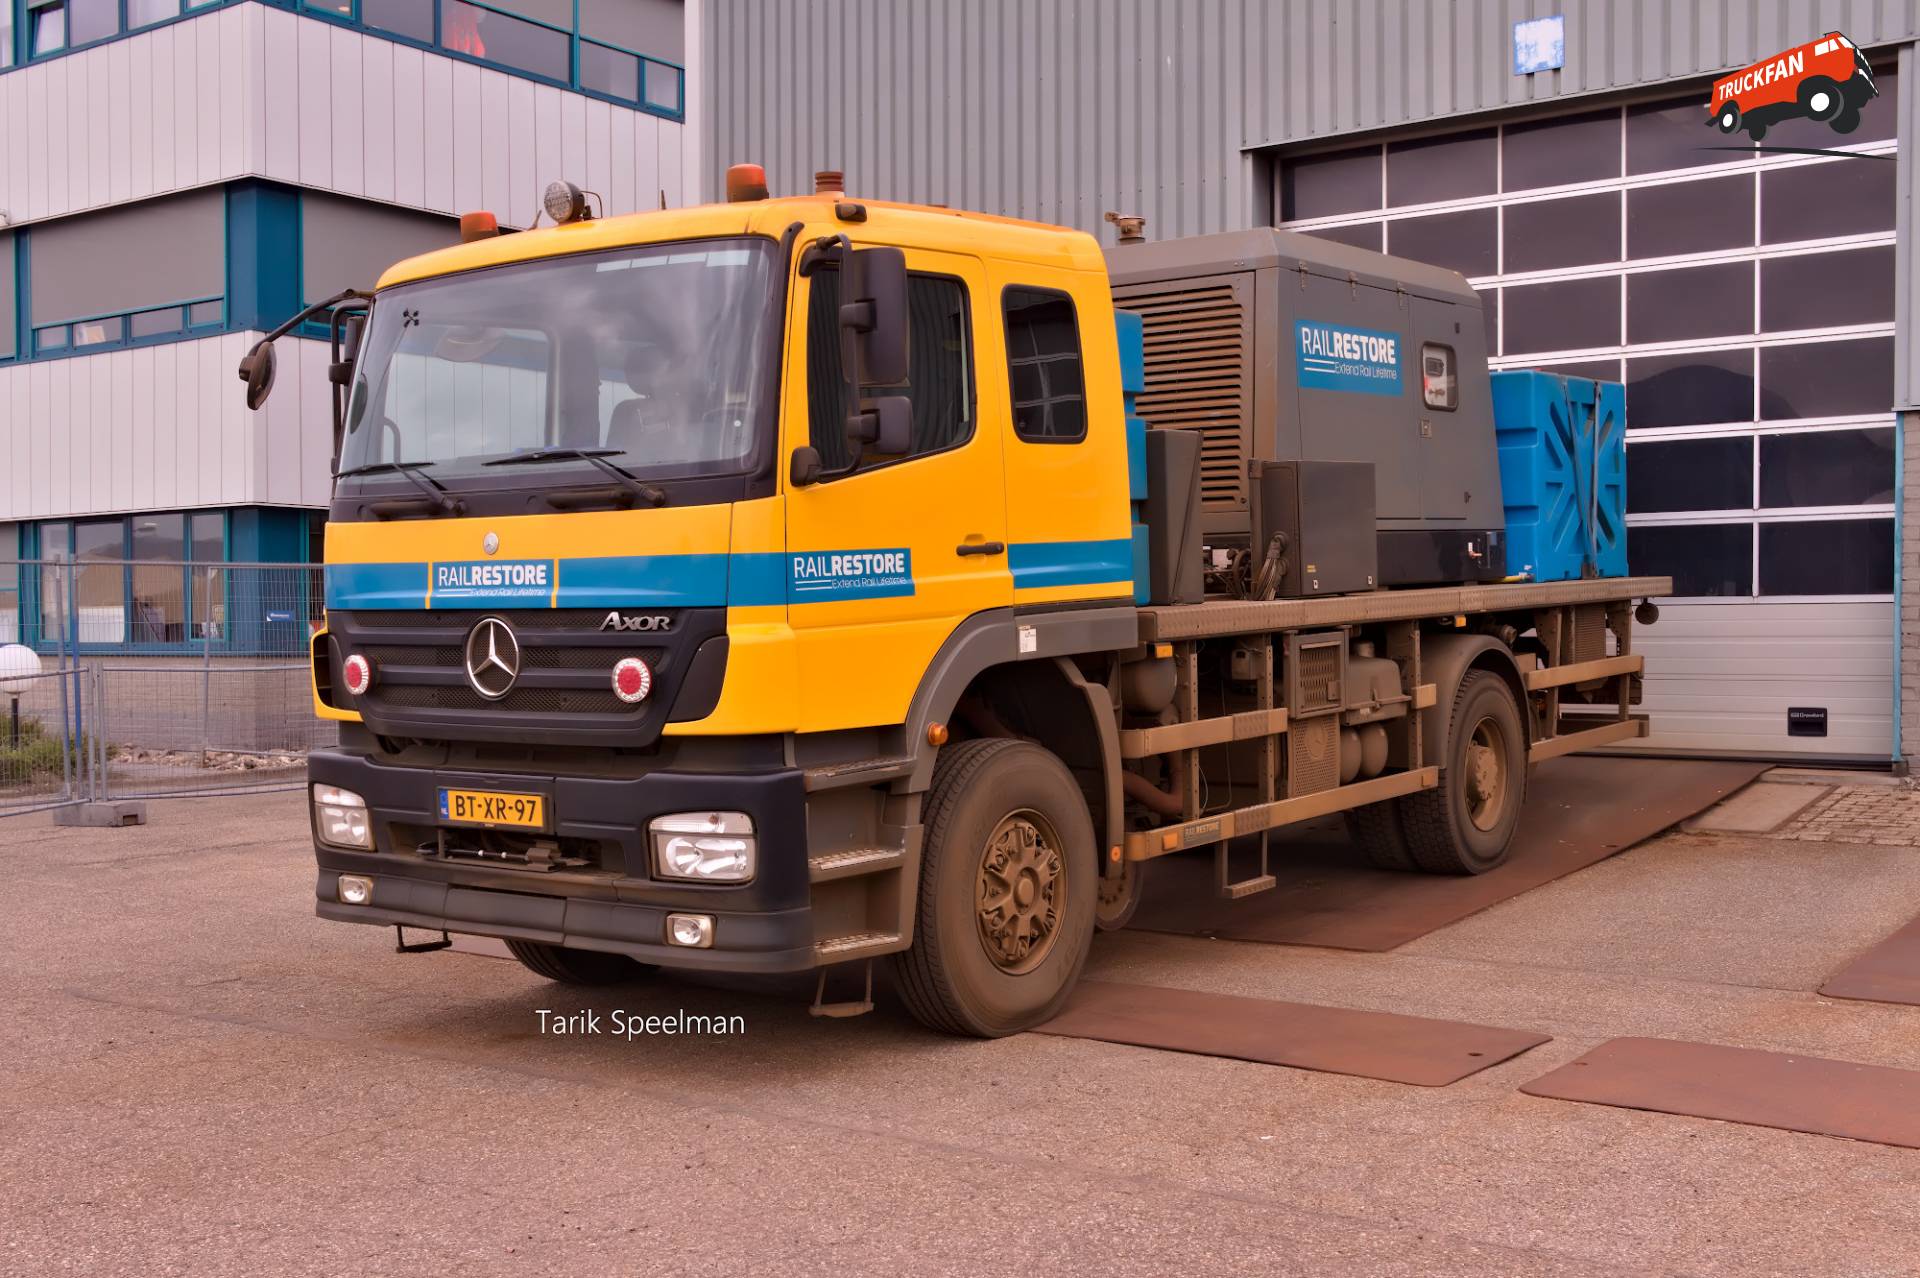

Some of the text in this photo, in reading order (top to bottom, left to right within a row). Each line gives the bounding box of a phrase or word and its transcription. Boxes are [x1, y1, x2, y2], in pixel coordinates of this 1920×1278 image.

[1301, 327, 1396, 364] RAILRESTORE
[1335, 362, 1359, 376] Extend
[1360, 365, 1372, 376] Rail
[439, 565, 547, 586] RAILRESTORE
[793, 553, 905, 578] RAILRESTORE
[832, 578, 860, 589] Extend
[861, 577, 876, 587] Rail
[455, 795, 537, 822] BT-XR-97
